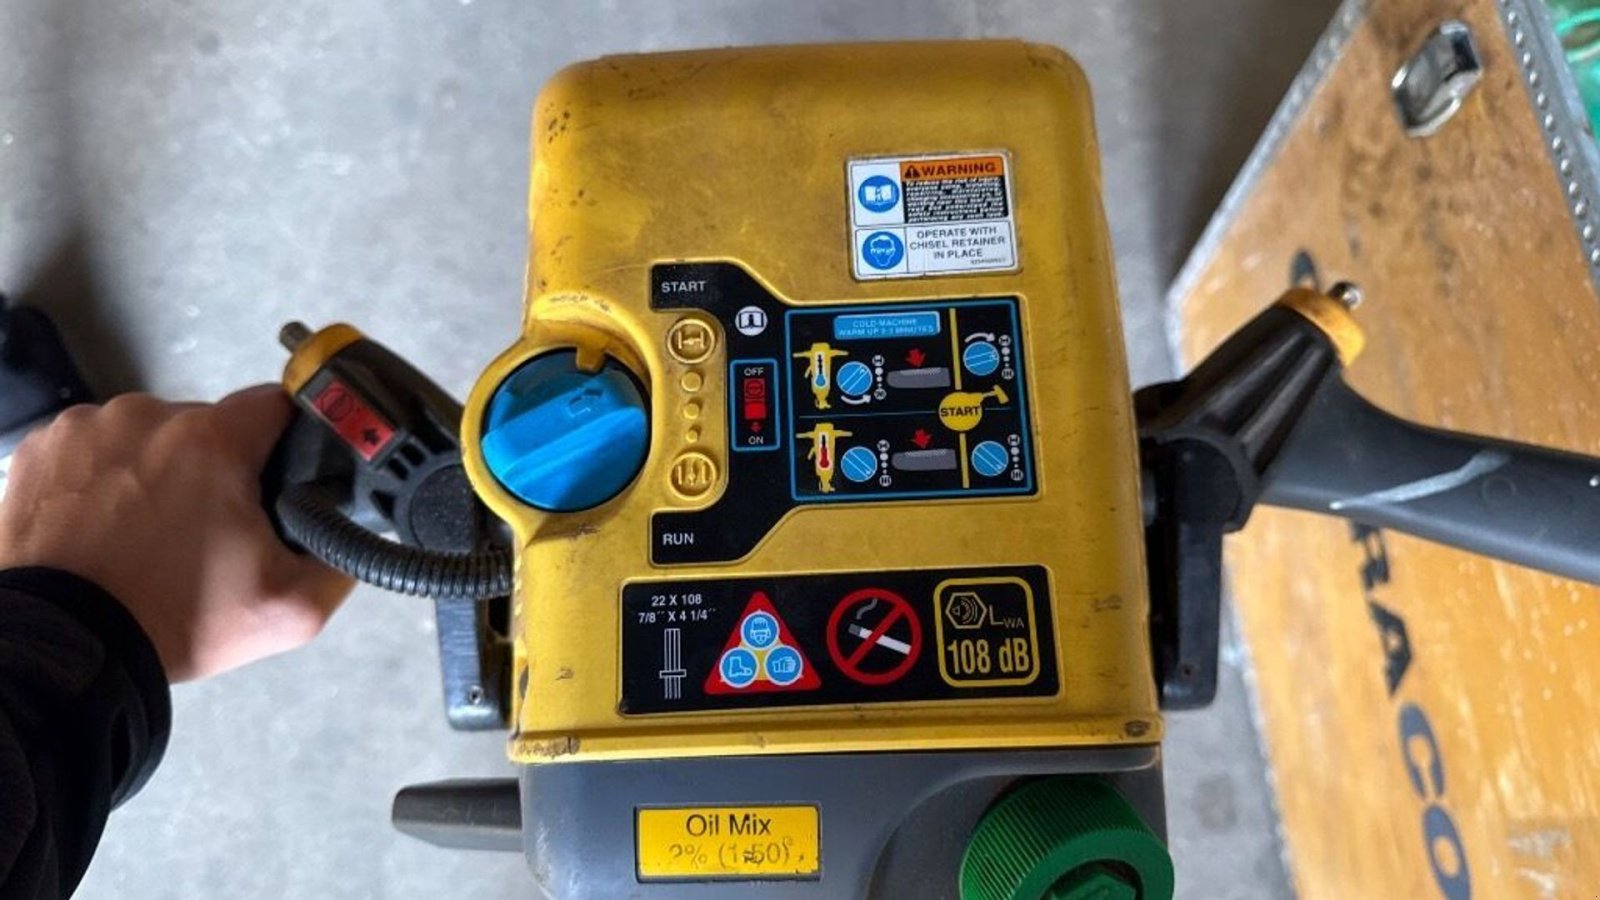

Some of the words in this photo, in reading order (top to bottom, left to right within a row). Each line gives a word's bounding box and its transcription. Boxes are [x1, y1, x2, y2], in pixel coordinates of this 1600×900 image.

[922, 162, 996, 176] WARNING
[917, 228, 967, 239] OPERATE
[969, 226, 997, 236] WITH
[910, 239, 949, 250] CHISEL
[952, 236, 1006, 248] RETAINER
[934, 251, 945, 259] IN
[947, 249, 983, 259] PLACE
[661, 280, 706, 293] START
[839, 328, 866, 337] WARM
[867, 327, 879, 336] UP
[744, 367, 765, 377] OFF
[940, 406, 980, 418] START
[748, 436, 764, 445] ON
[662, 532, 695, 546] RUN
[651, 595, 666, 607] 22
[681, 593, 702, 605] 108
[680, 610, 686, 622] 4
[947, 638, 991, 675] 108
[999, 637, 1030, 673] dB
[686, 813, 719, 837] Oil
[729, 813, 772, 836] Mix
